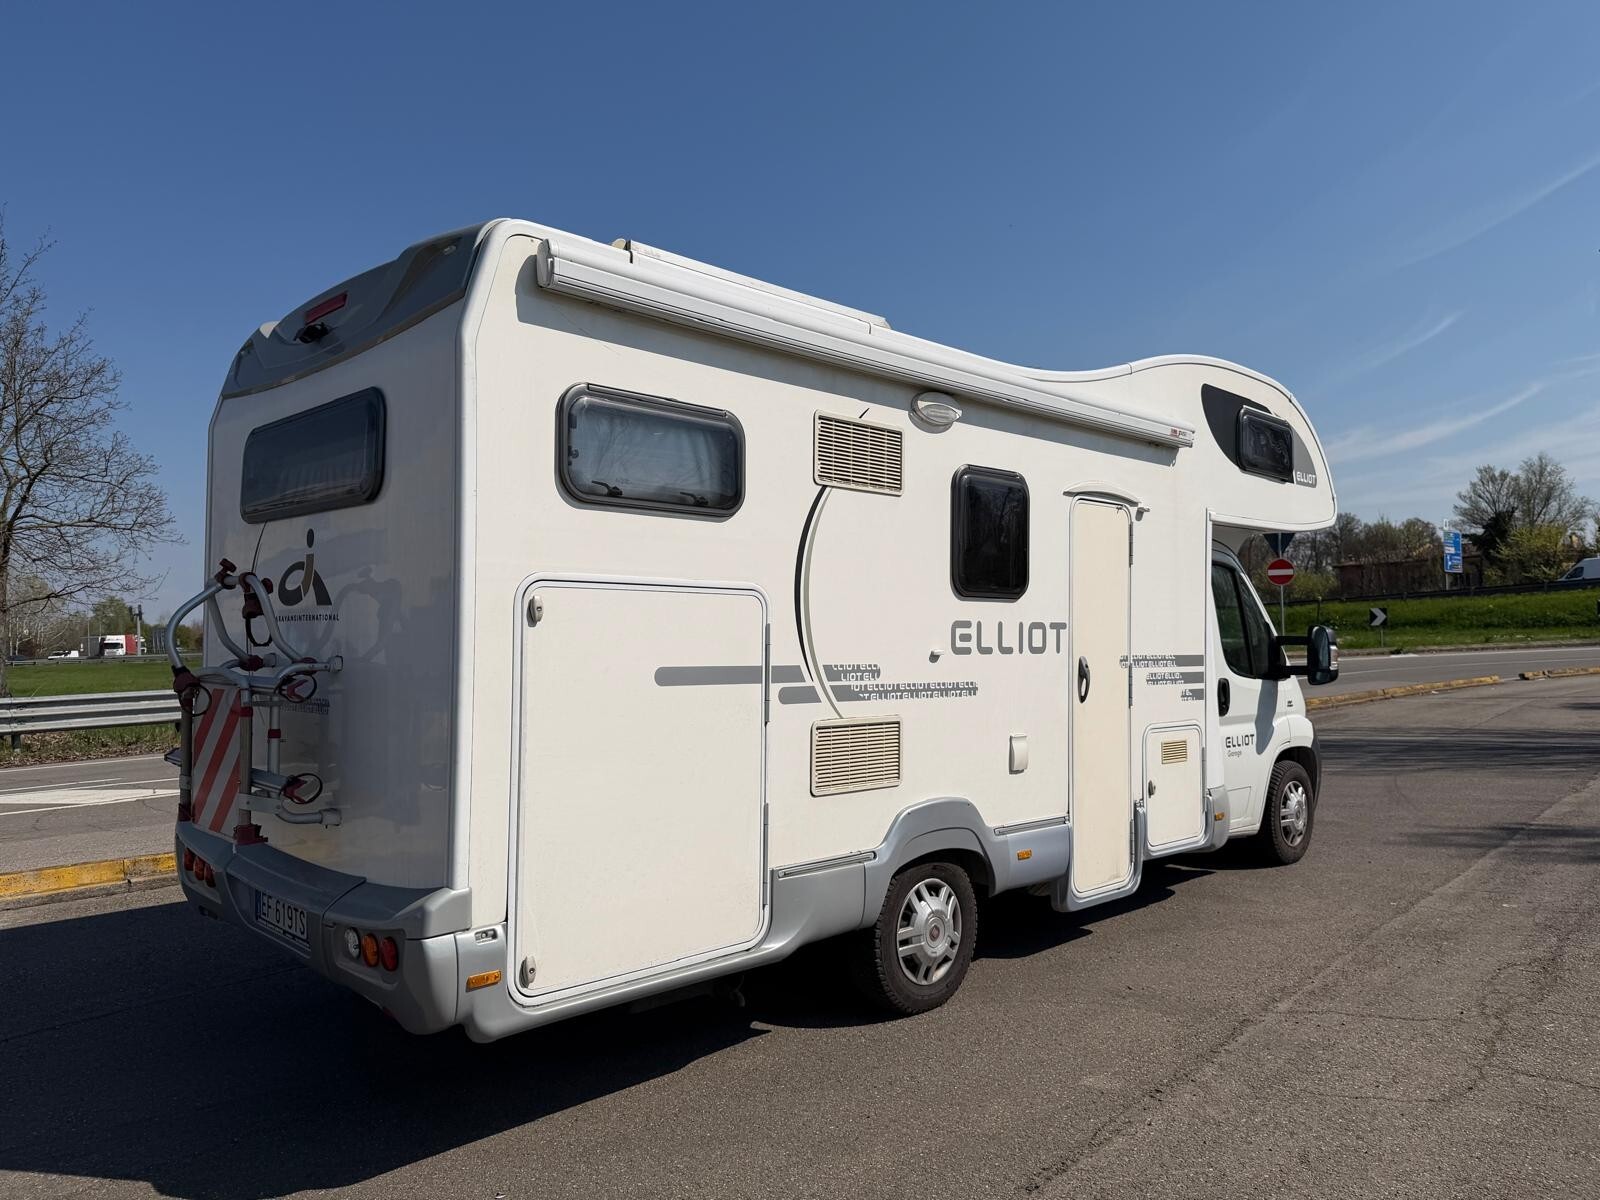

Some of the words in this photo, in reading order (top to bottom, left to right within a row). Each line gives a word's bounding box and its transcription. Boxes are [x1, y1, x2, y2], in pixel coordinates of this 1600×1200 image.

[1296, 471, 1316, 485] ELLIOT
[950, 620, 1067, 655] ELLIOT
[1225, 733, 1255, 749] ELLIOT
